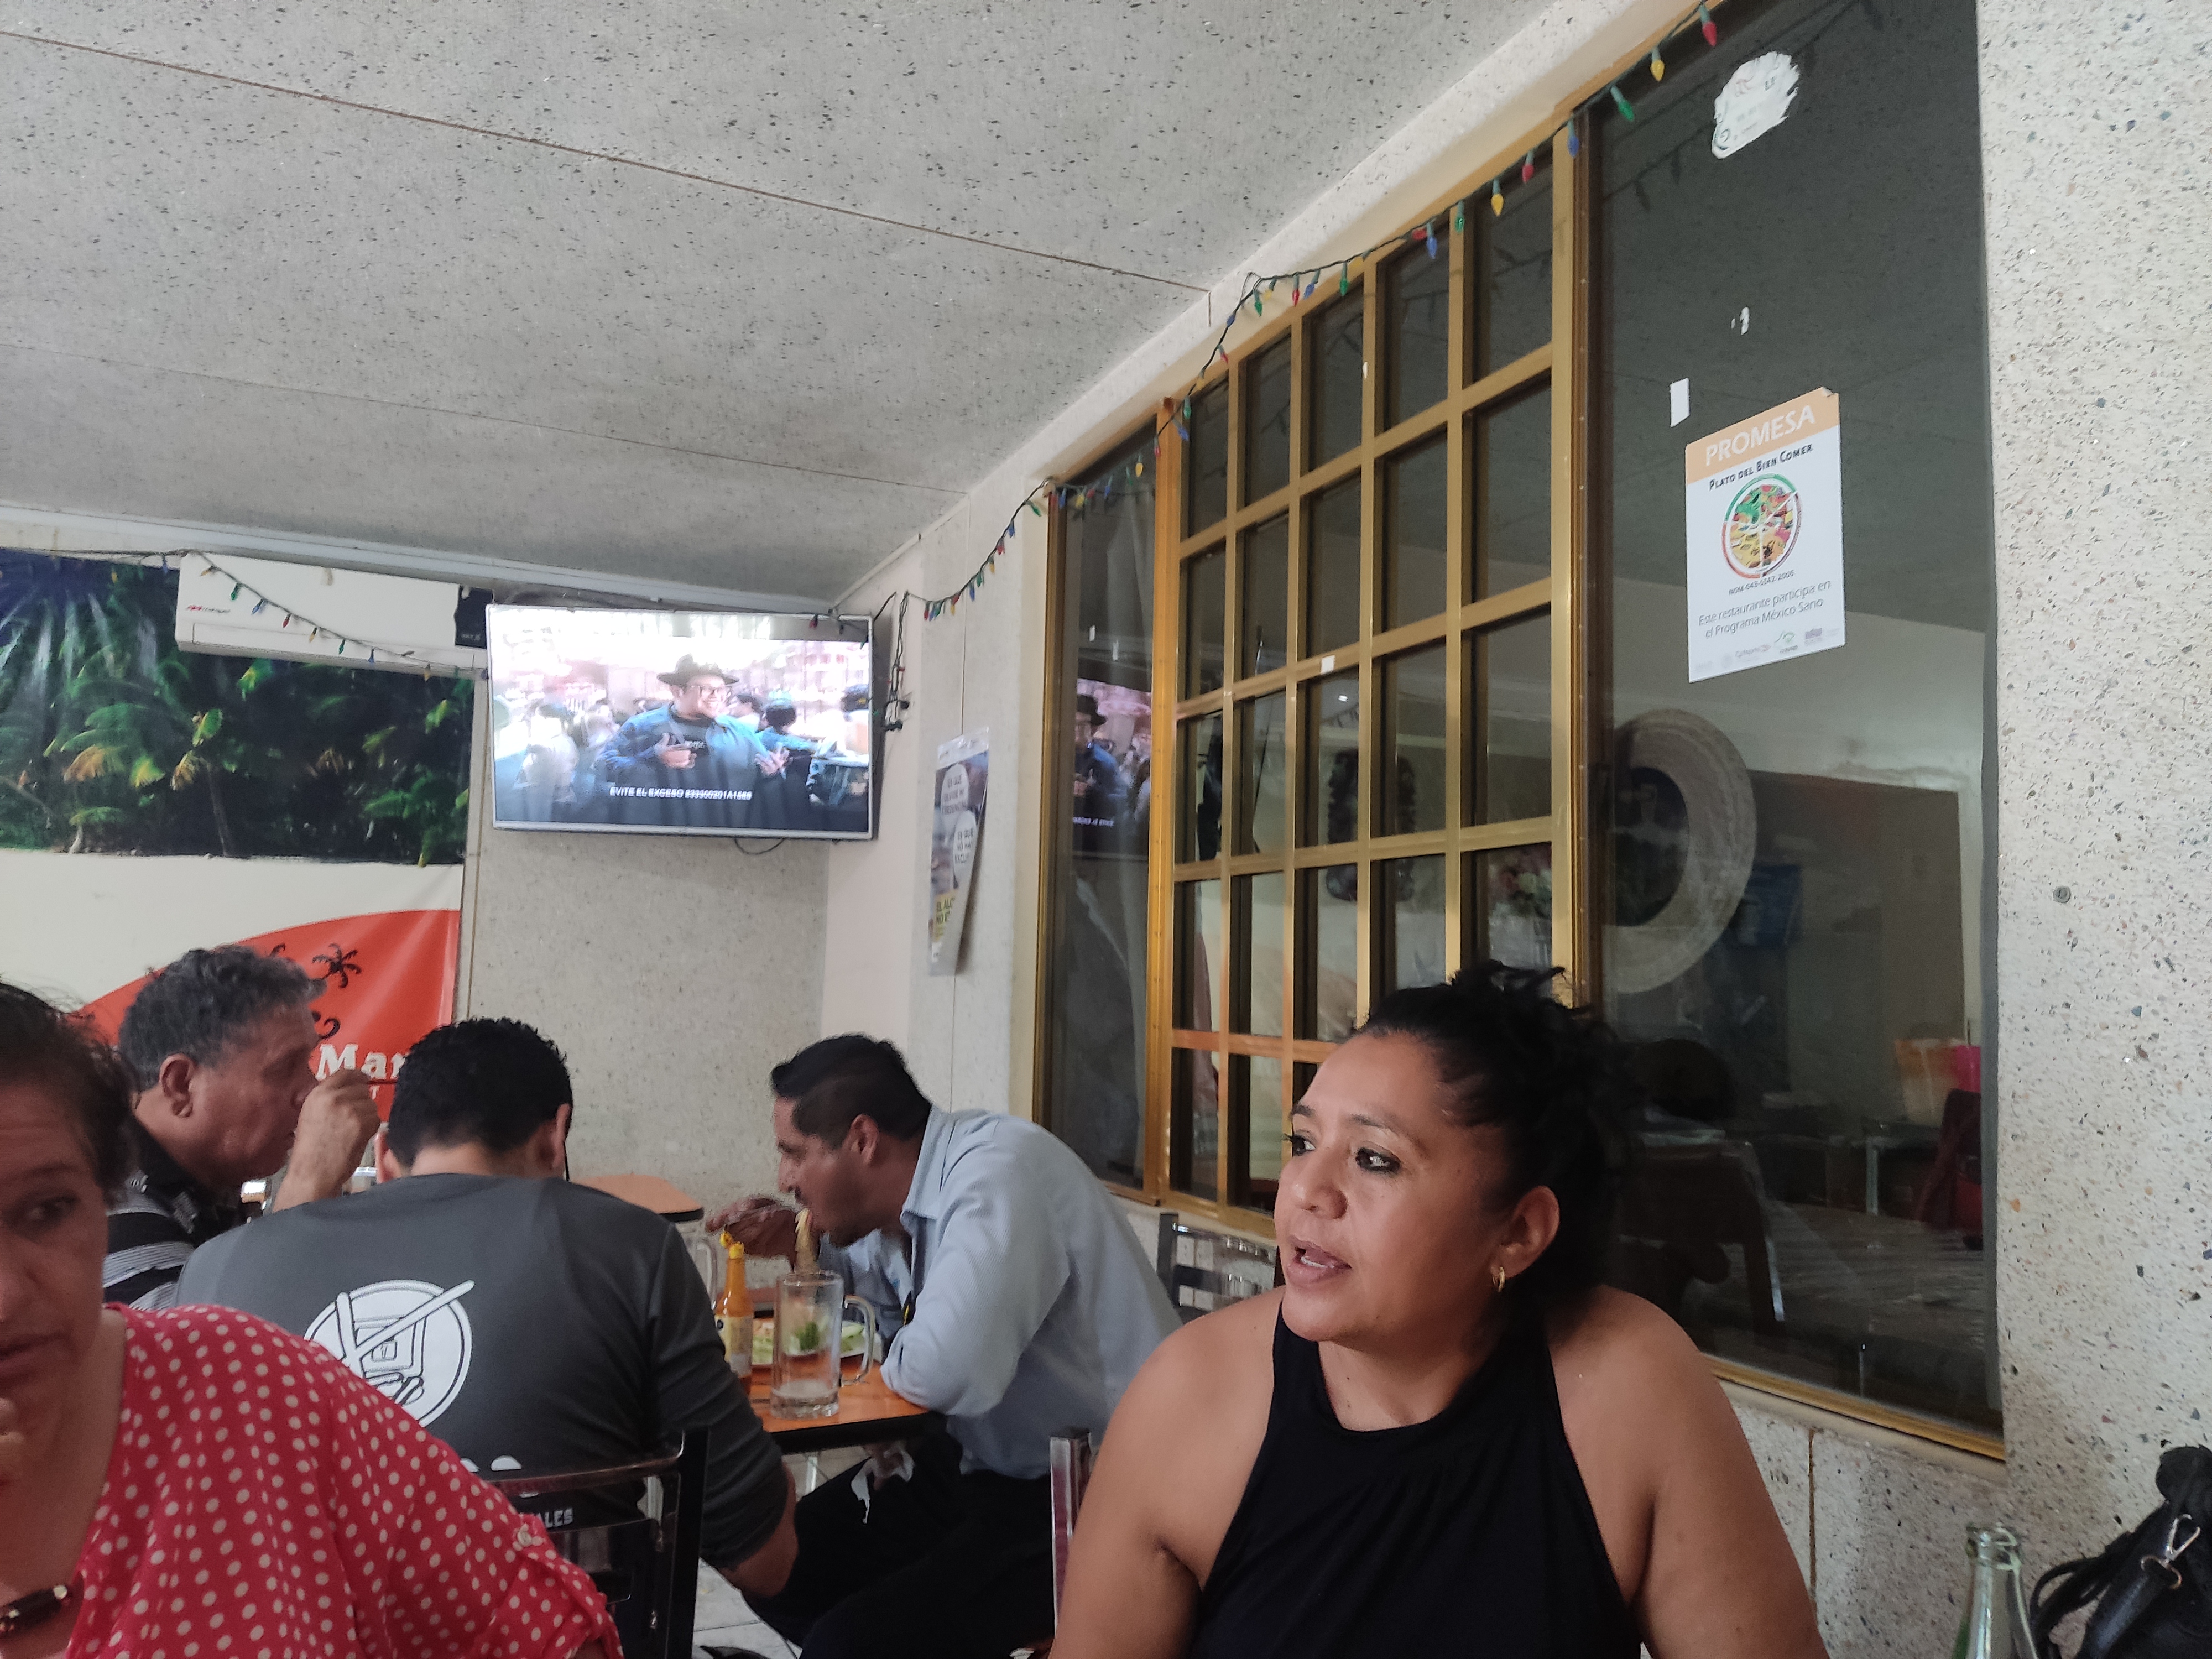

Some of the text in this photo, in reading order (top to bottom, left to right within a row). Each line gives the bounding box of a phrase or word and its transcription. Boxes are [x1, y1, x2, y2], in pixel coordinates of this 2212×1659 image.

[1705, 405, 1815, 467] PROMESA
[1699, 581, 1831, 626] Este restaurante participa en
[1705, 598, 1824, 639] el Programa México Sano
[609, 786, 635, 796] EVITE
[636, 787, 648, 797] EL
[648, 787, 684, 798] EXCESO
[315, 1044, 406, 1082] Mar
